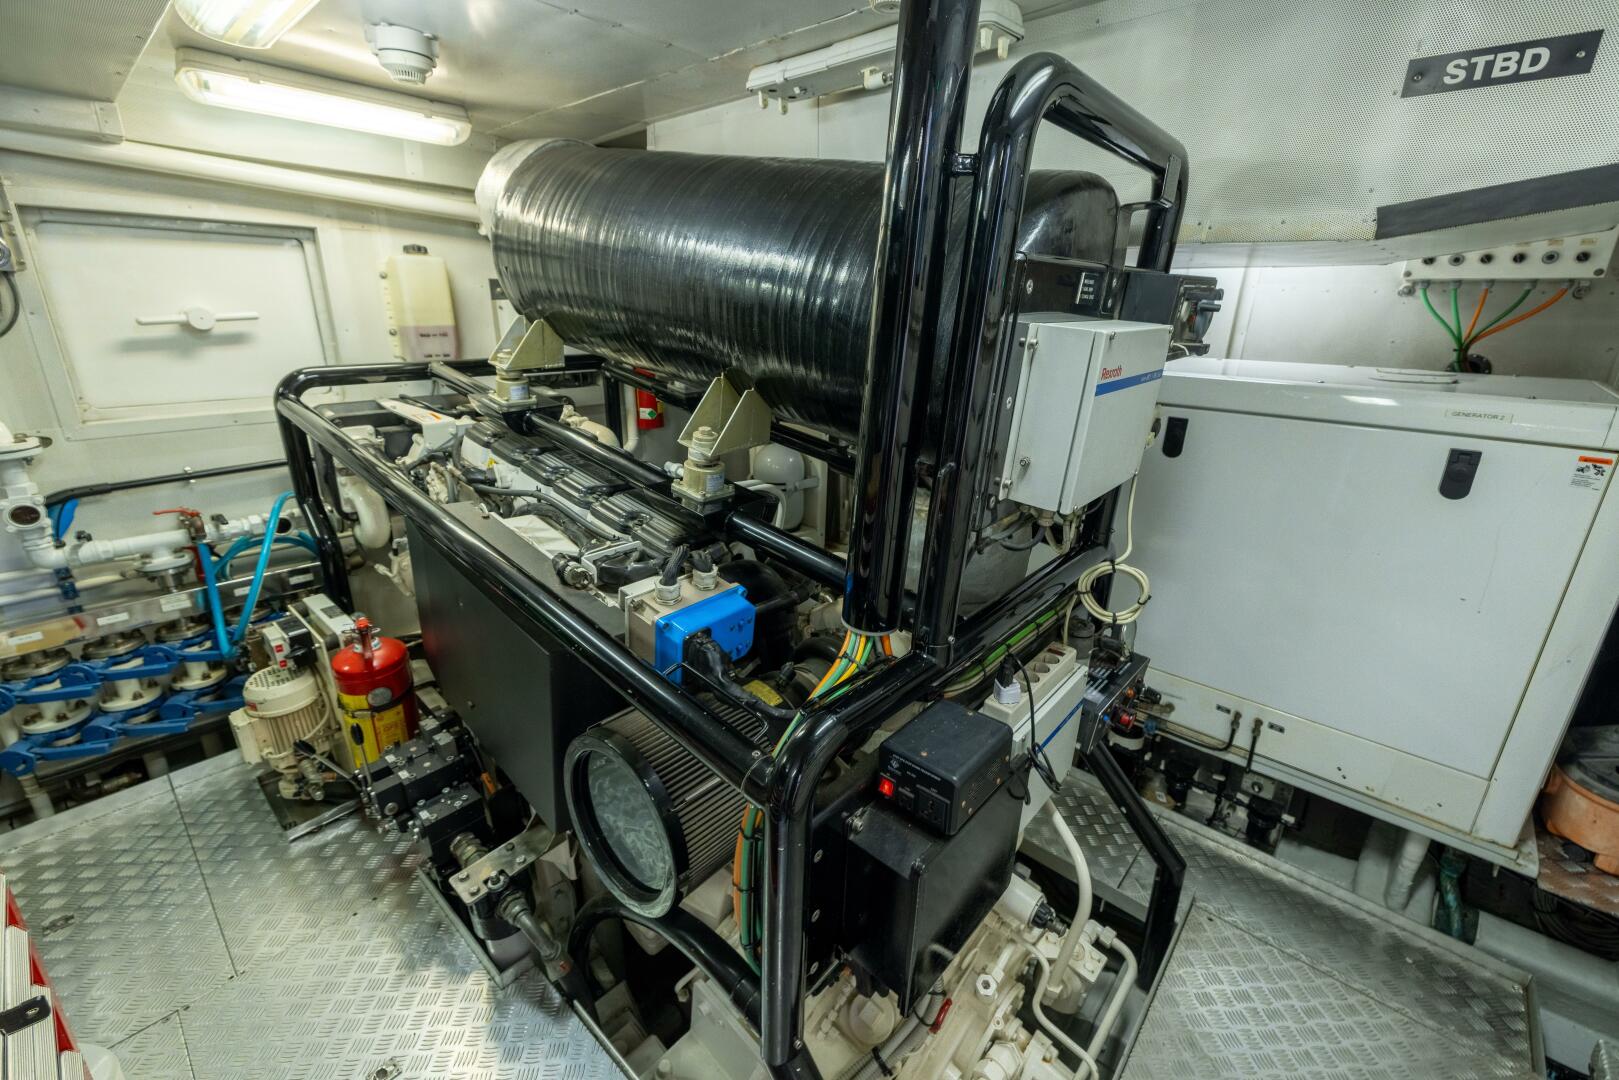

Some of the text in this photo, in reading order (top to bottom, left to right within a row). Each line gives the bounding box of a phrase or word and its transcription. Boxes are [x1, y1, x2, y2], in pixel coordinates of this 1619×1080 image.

[1443, 46, 1551, 85] STBD
[1101, 364, 1123, 381] Rexroth
[1450, 411, 1498, 420] GENERATOR
